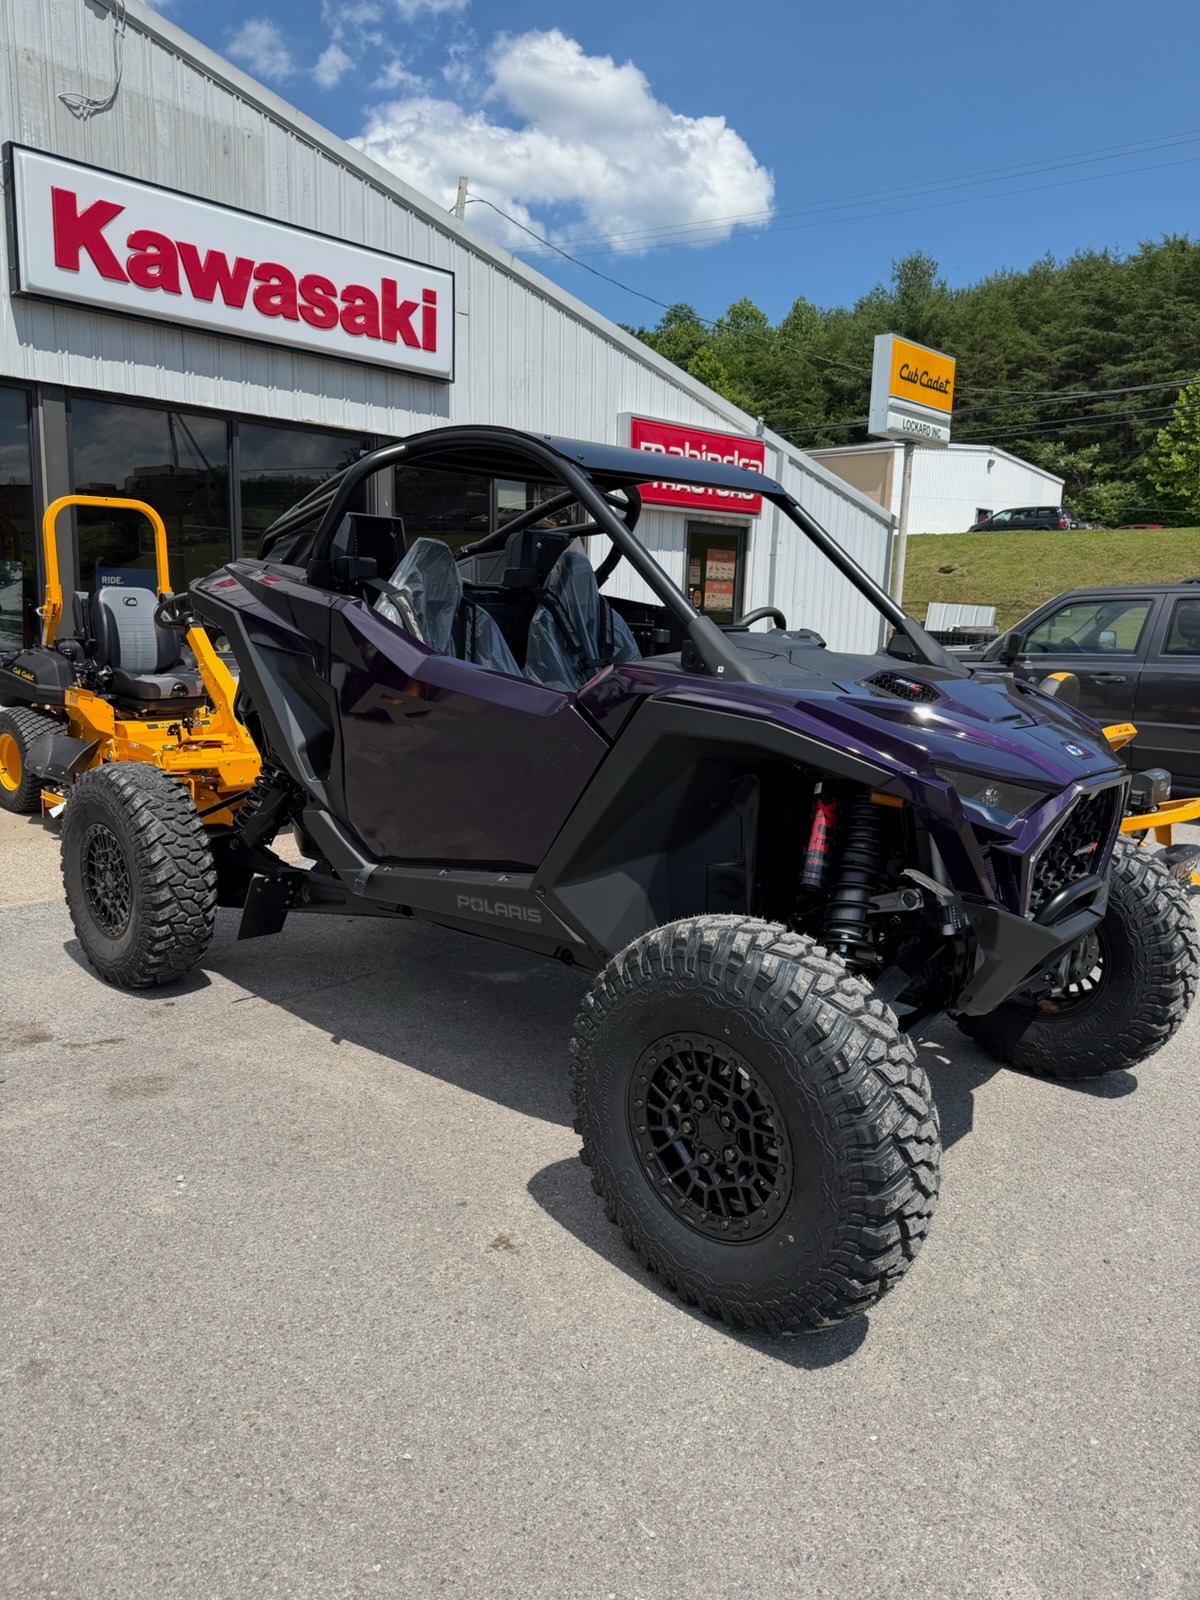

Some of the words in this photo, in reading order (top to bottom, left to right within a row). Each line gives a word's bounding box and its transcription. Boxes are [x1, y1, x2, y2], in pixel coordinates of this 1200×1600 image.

[50, 185, 437, 353] Kawasaki
[899, 363, 918, 384] Cub
[919, 370, 950, 394] Cadet
[902, 418, 930, 436] LOCKARD
[101, 576, 124, 584] RIDE.
[456, 895, 542, 923] POLARIS
